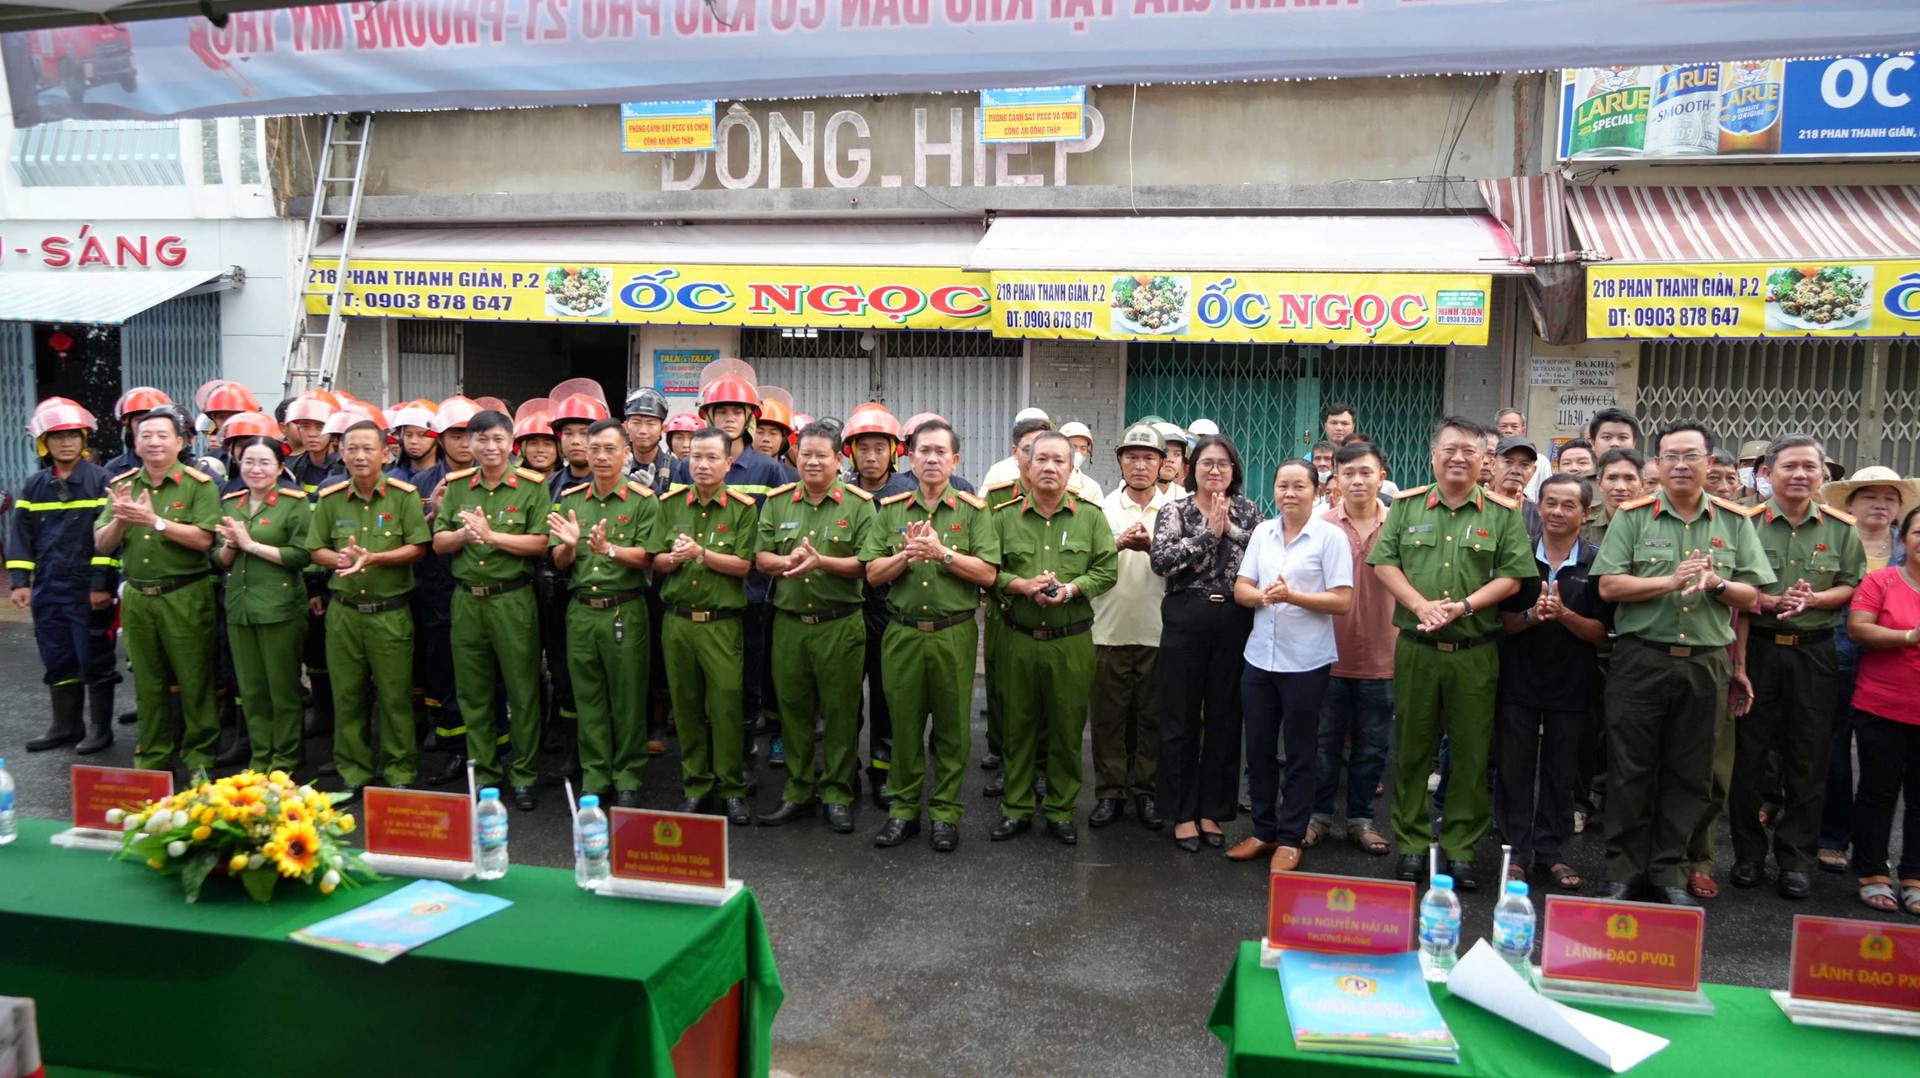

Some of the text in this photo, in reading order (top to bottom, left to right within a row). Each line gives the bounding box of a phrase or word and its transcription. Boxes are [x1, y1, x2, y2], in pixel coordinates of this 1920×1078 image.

[1657, 68, 1718, 98] LARUE
[1578, 89, 1650, 126] LARUE
[1720, 84, 1778, 111] LARUE
[1037, 113, 1051, 121] PCCC
[1657, 99, 1710, 123] SMOOTH
[672, 123, 686, 132] PCCC
[1021, 127, 1028, 135] AN
[1592, 114, 1634, 132] SPECIAL
[1798, 129, 1819, 139] 218
[1820, 128, 1849, 138] PHAN
[1851, 128, 1886, 138] THANH
[658, 137, 666, 145] AN
[41, 223, 188, 267] SÁNG
[308, 269, 337, 284] 218
[394, 270, 453, 287] THANH
[458, 267, 507, 289] GIẢN,
[512, 273, 540, 289] P.2
[1593, 272, 1759, 299] 218 PHAN THANH GIẢN, P.2
[364, 292, 420, 310] 0903
[427, 293, 466, 310] 878
[472, 294, 513, 311] 647
[619, 268, 991, 324] ỐC NGỌC
[996, 279, 1106, 303] 218 PHAN THANH GIẢN, P.2
[1197, 276, 1430, 338] ỐC NGỌC
[1608, 306, 1739, 327] ĐT: 0903 878 647
[1007, 311, 1093, 329] ĐT: 0903 878 647
[661, 354, 681, 363] TALK
[690, 354, 713, 363] TALK
[1575, 360, 1588, 368] BA
[1558, 409, 1584, 426] 11h30
[1382, 923, 1398, 935] AN
[1565, 942, 1677, 968] LÃNH ĐẠO PV01
[1810, 963, 1853, 981] LÃNH
[1857, 969, 1894, 987] ĐẠO
